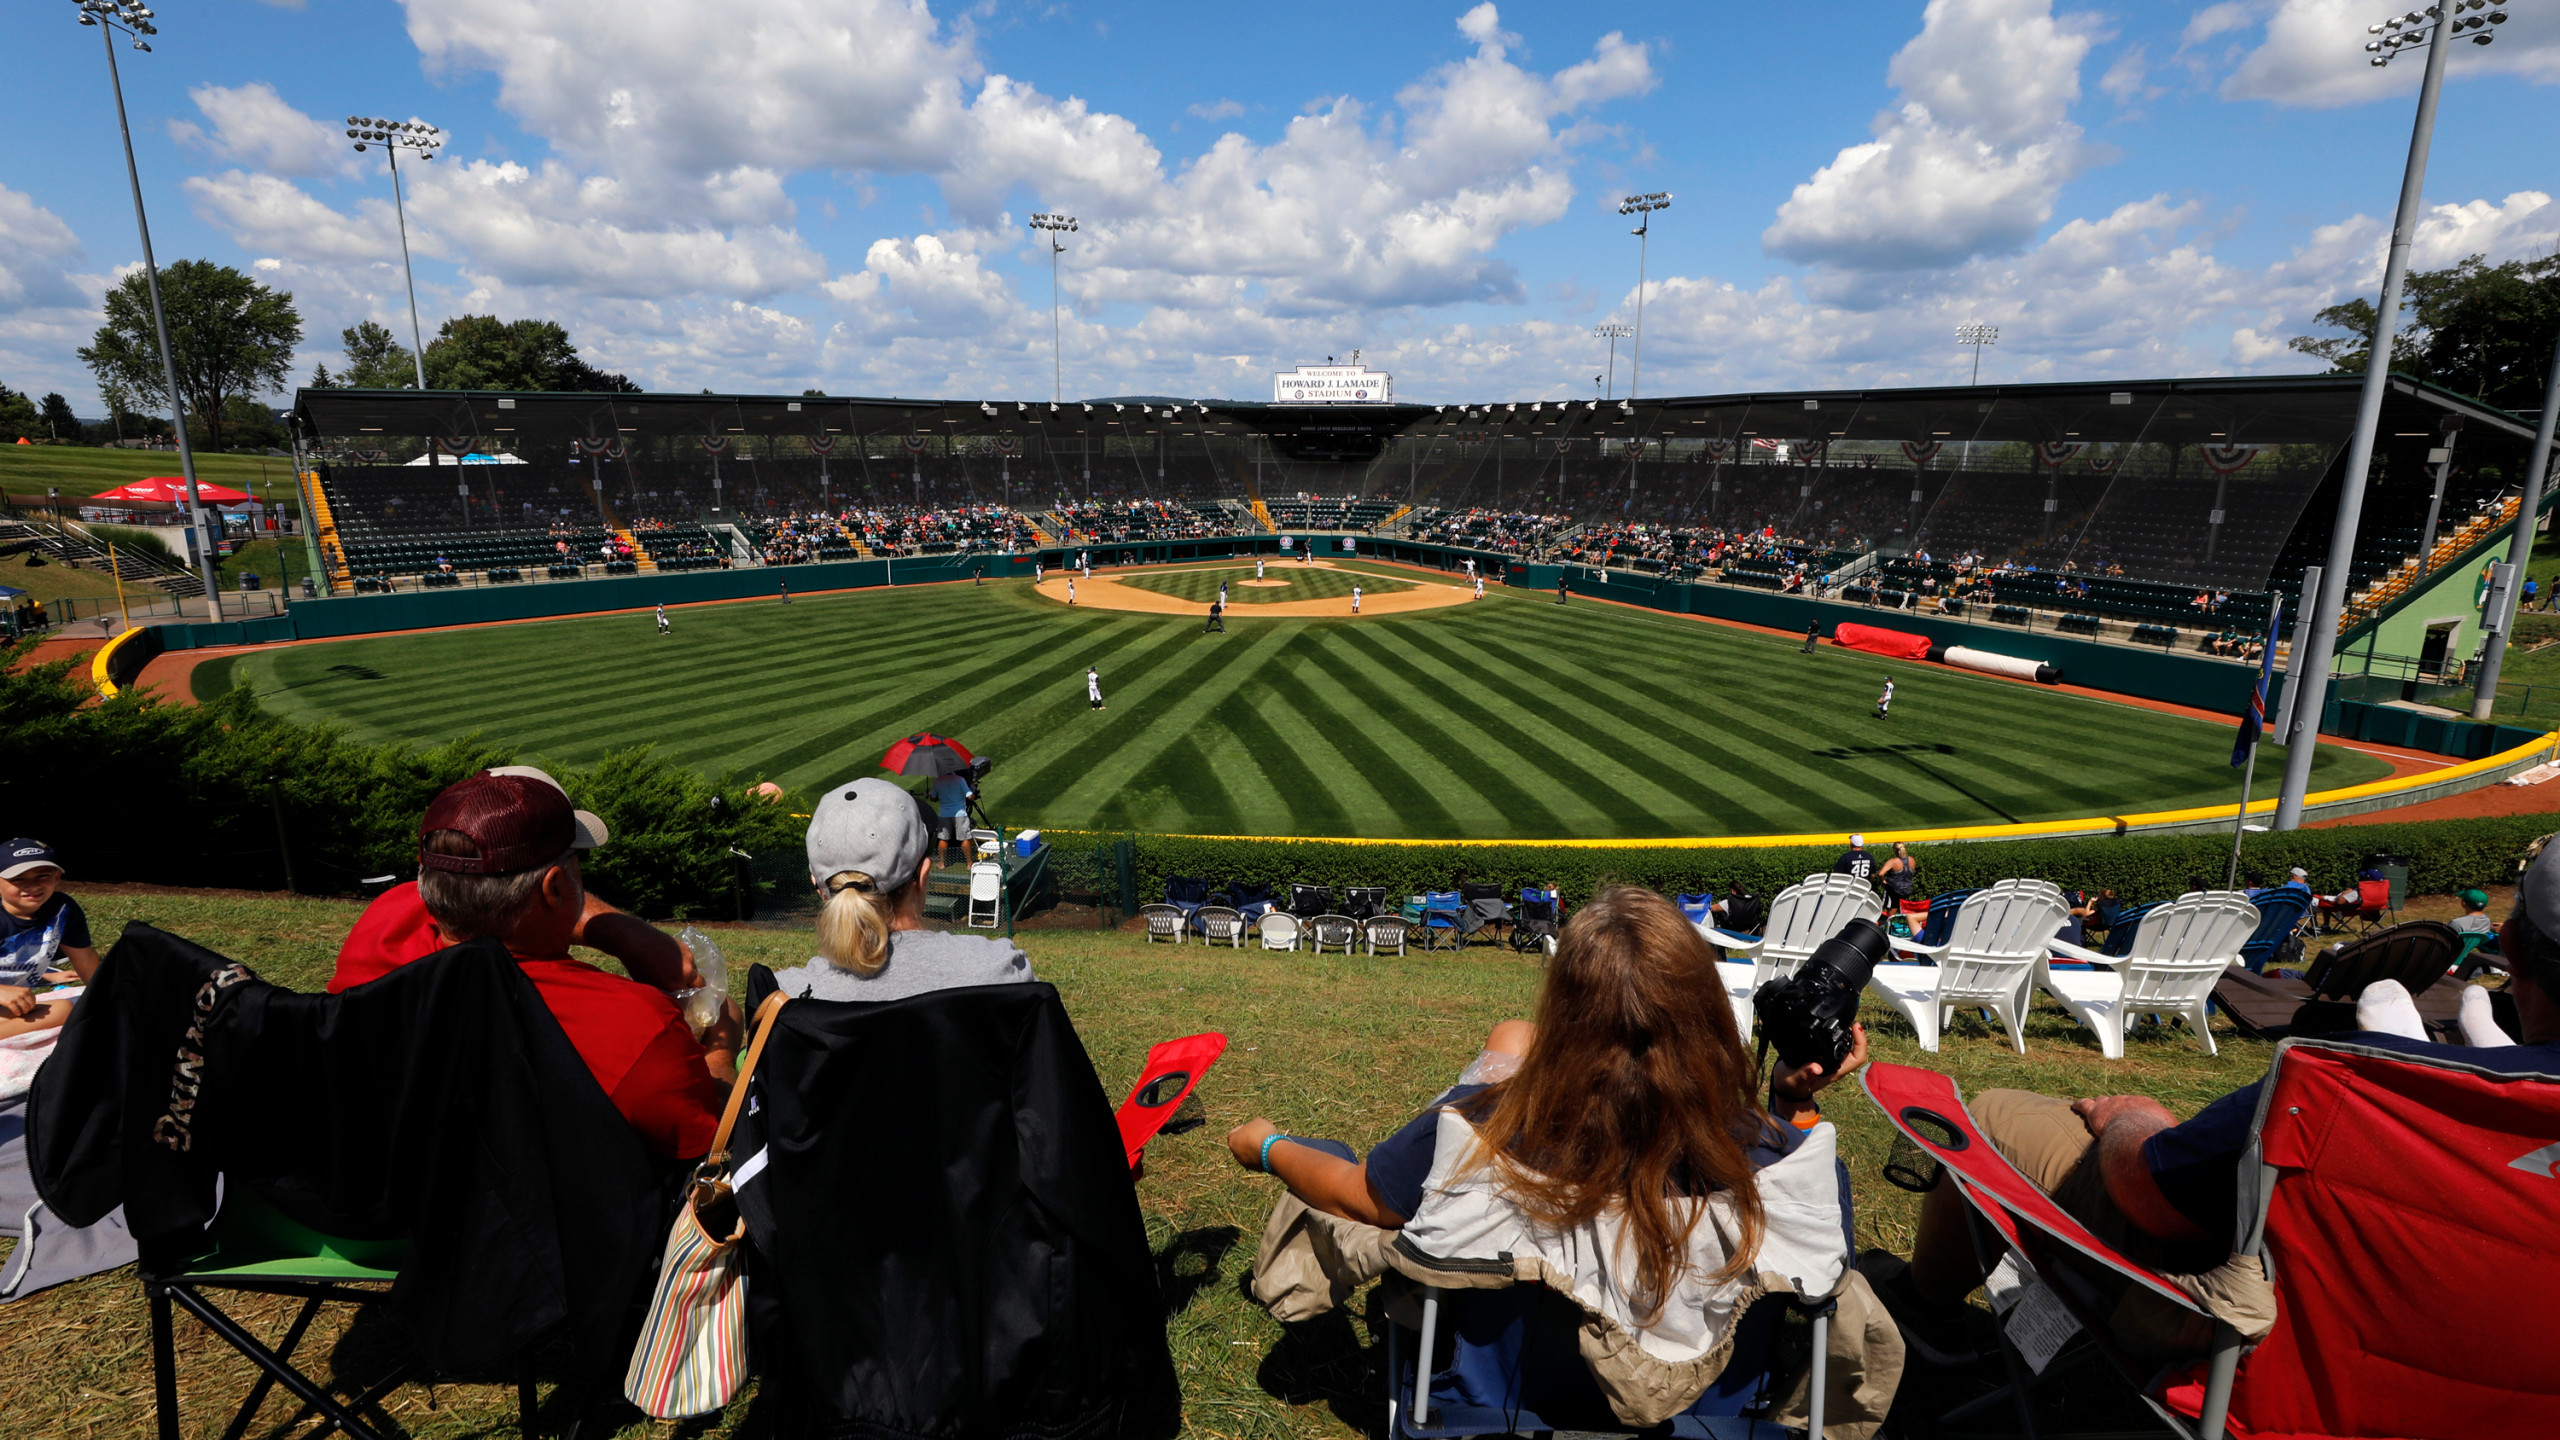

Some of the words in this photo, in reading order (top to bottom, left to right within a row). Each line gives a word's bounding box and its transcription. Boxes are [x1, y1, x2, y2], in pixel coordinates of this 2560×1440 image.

[1282, 380, 1325, 388] HOWARD
[1327, 380, 1334, 388] J.
[1336, 380, 1380, 388] LAMADE
[1851, 864, 1870, 877] 46
[152, 962, 256, 1153] ROWNING
